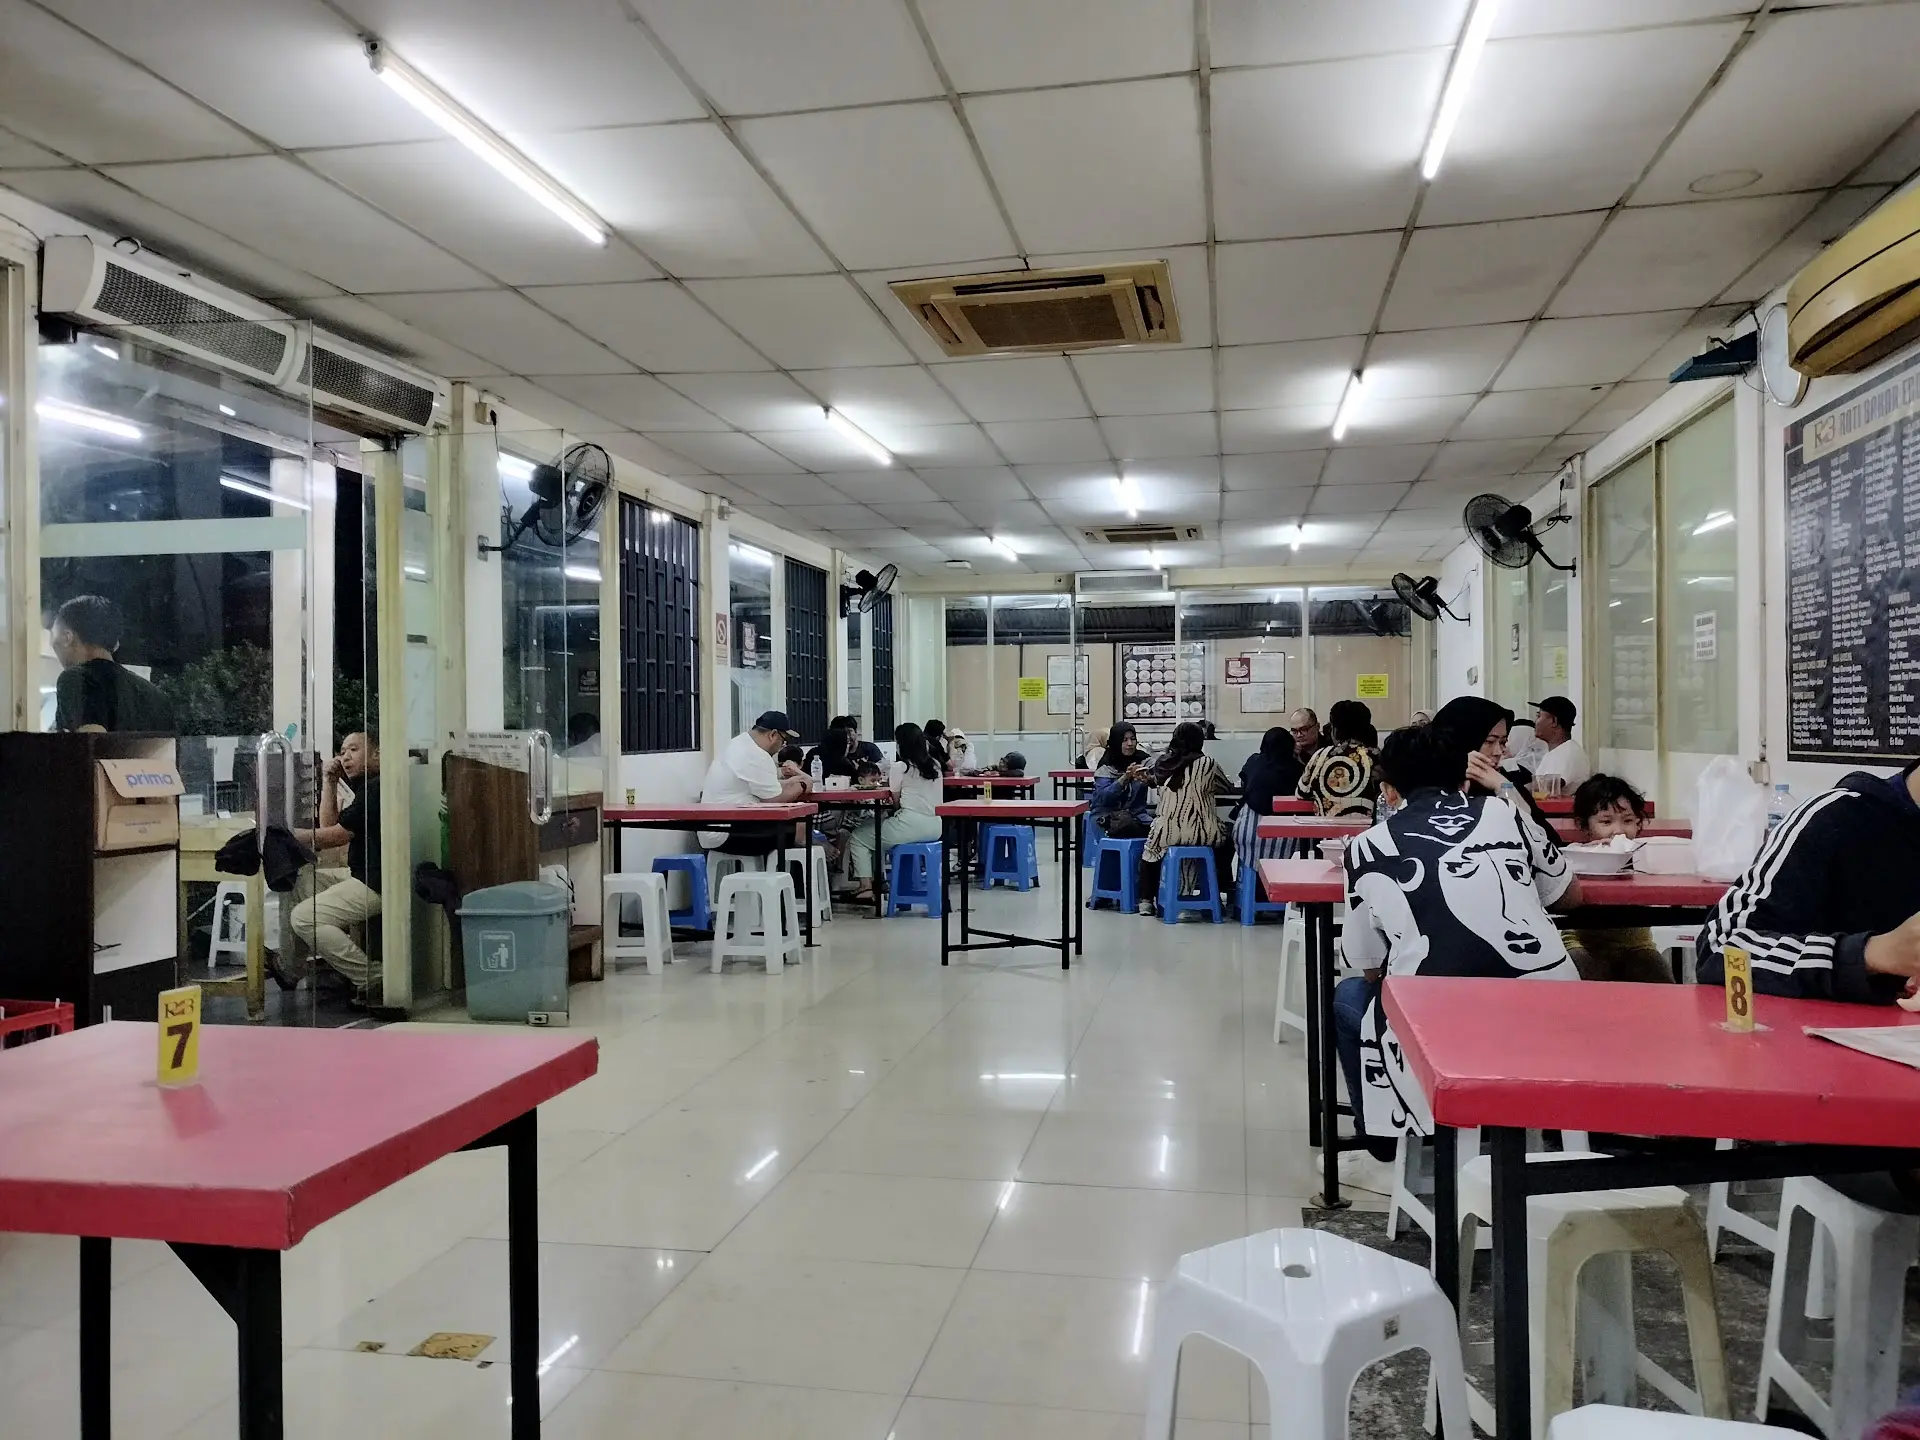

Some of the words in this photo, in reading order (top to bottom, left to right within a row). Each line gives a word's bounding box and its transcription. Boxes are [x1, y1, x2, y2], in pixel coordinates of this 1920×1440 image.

[1839, 403, 1861, 437] ROTI
[125, 769, 173, 788] prima
[626, 794, 635, 805] 12
[1730, 975, 1748, 1017] 8
[167, 1021, 194, 1070] 7
